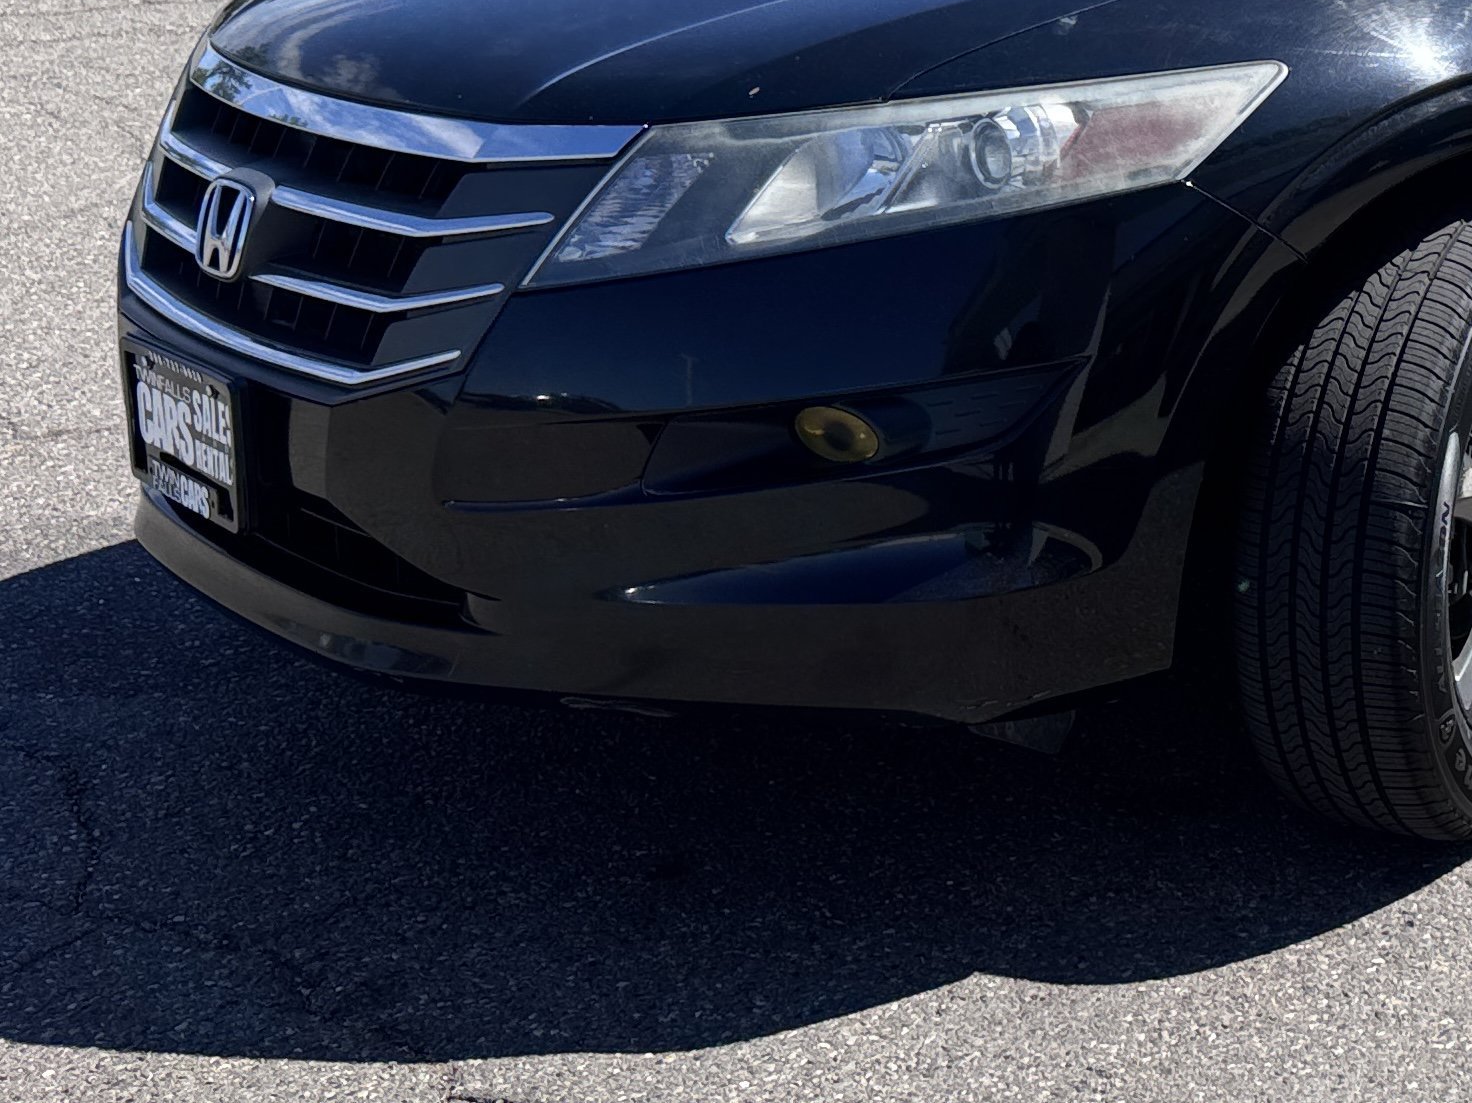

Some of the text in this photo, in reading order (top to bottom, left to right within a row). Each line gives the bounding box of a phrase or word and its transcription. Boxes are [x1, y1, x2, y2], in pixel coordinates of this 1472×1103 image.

[136, 381, 195, 467] CARS
[152, 459, 180, 488] TWIN
[180, 474, 210, 519] CARS
